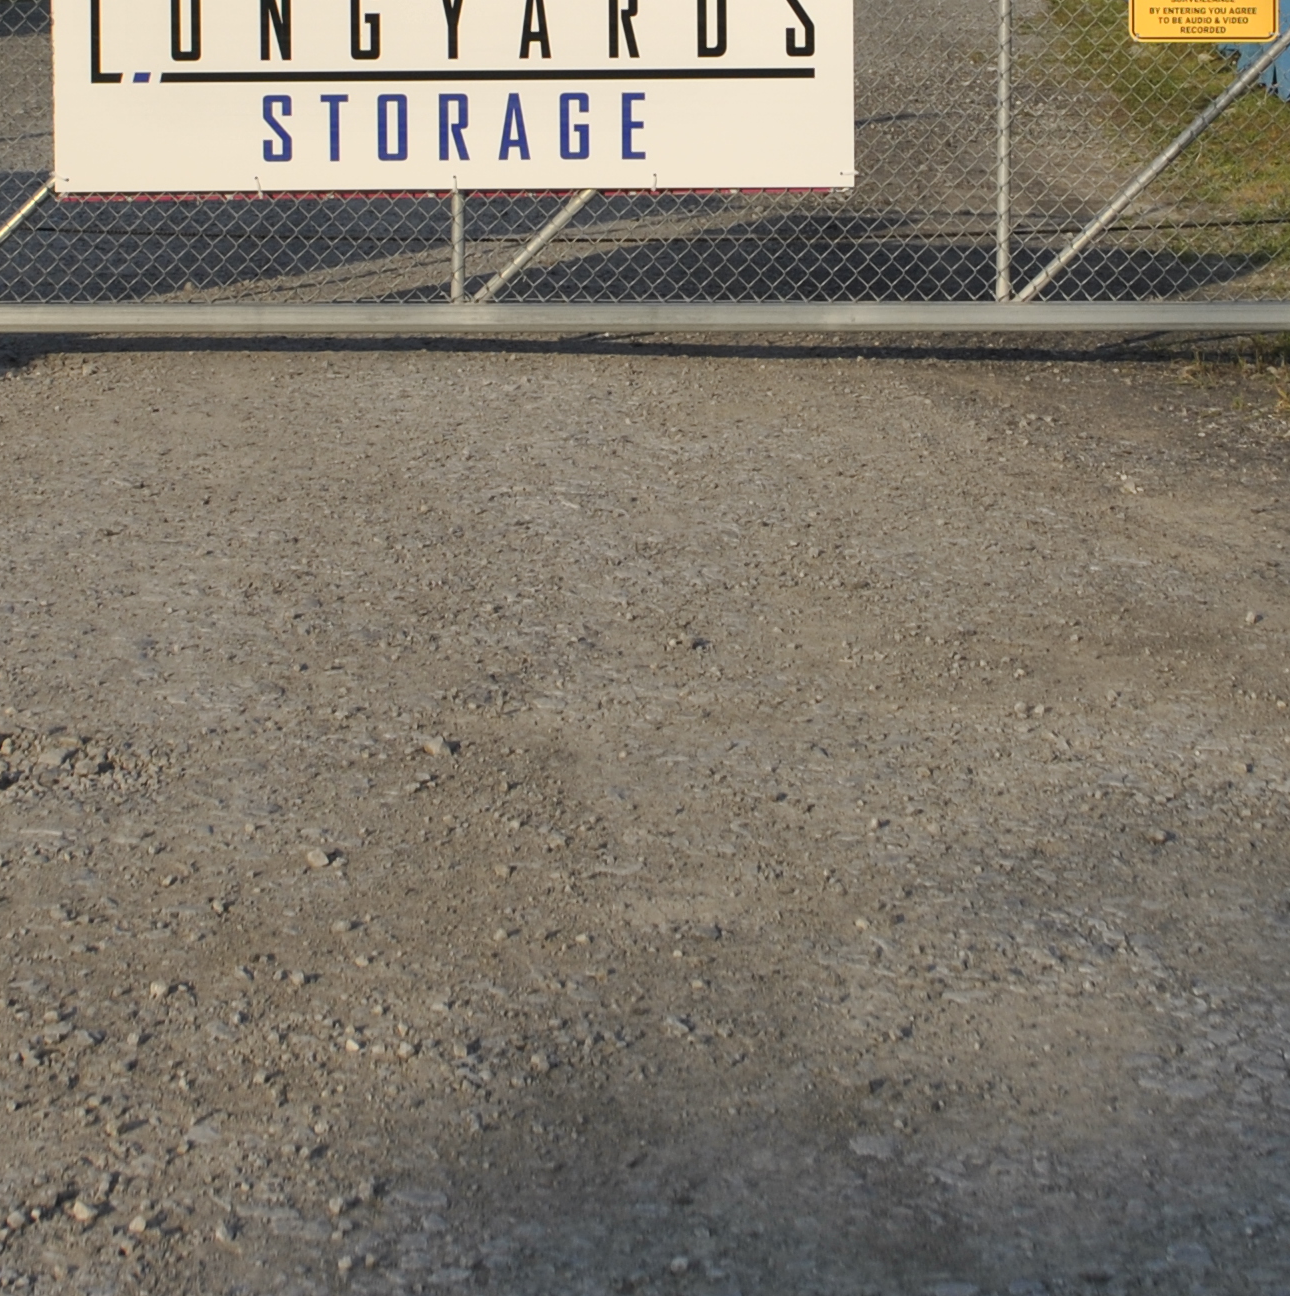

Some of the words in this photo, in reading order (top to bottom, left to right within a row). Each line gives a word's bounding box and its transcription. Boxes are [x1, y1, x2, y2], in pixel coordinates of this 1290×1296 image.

[1149, 7, 1160, 15] BY
[1163, 7, 1206, 15] ENTERING
[1209, 7, 1227, 15] YOU
[1229, 7, 1257, 15] AGREE
[1180, 26, 1226, 34] RECORDED
[262, 92, 646, 163] STORAGE
